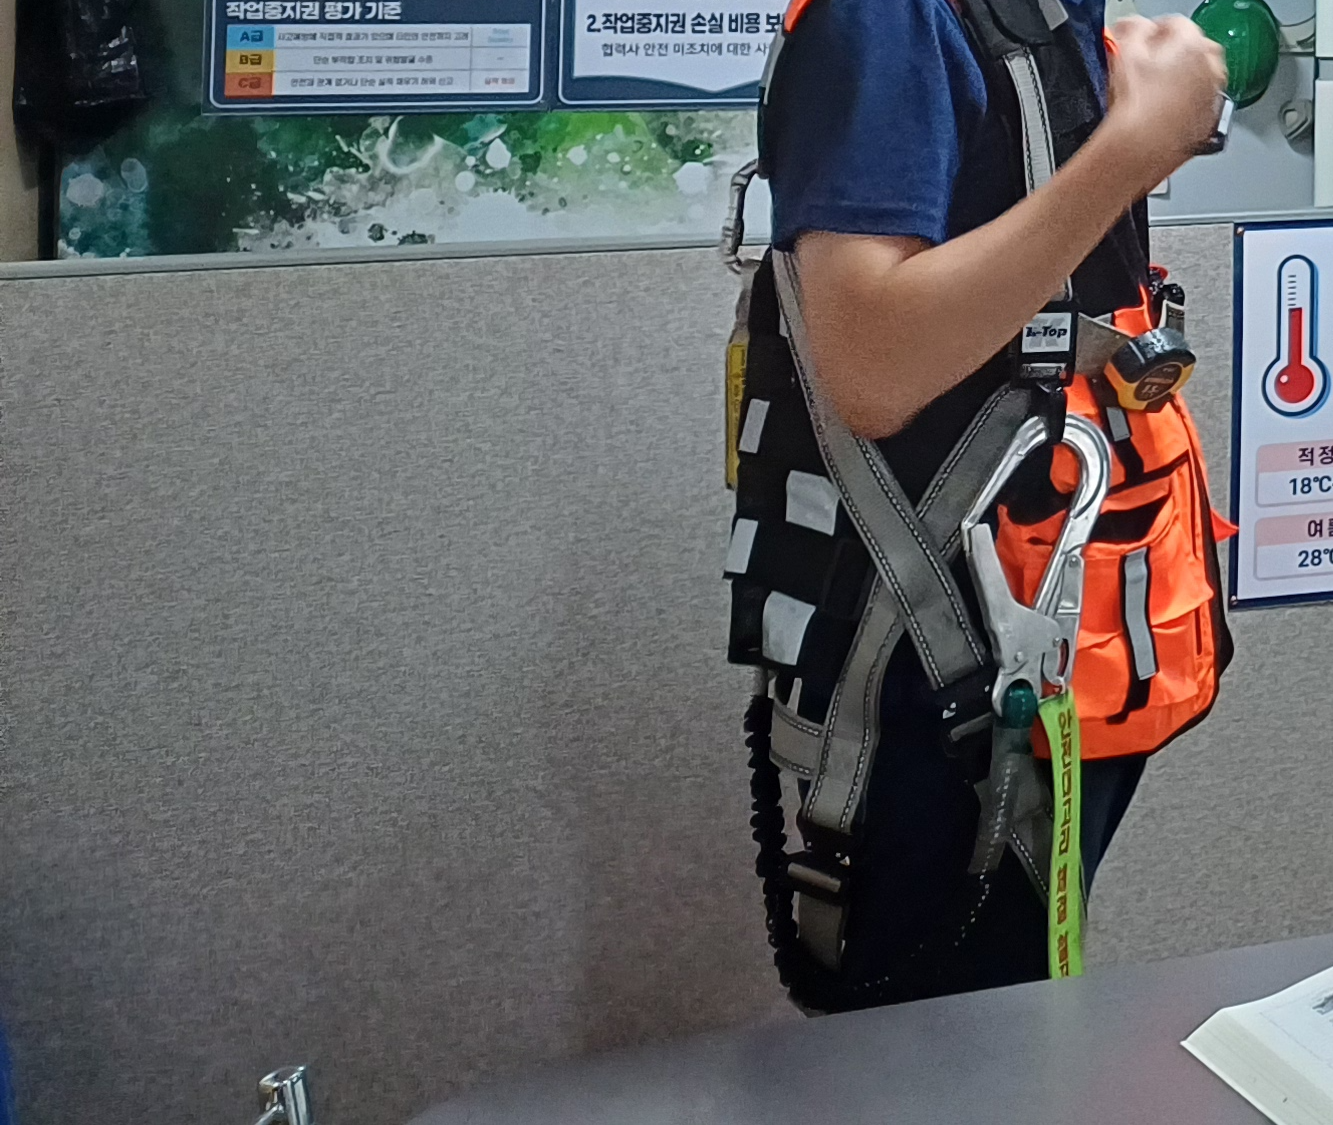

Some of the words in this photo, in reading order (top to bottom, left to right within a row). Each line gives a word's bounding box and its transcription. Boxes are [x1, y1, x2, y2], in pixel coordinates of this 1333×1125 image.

[226, 2, 319, 20] 작업중지권
[323, 2, 363, 21] 평가
[364, 2, 402, 20] 기준
[586, 13, 686, 34] 2.작업중지권
[691, 13, 724, 34] 손실
[728, 13, 760, 34] 비용
[601, 42, 640, 57] 협력사
[643, 43, 669, 57] 안전
[673, 42, 723, 57] 미조치에
[726, 42, 751, 57] 대한
